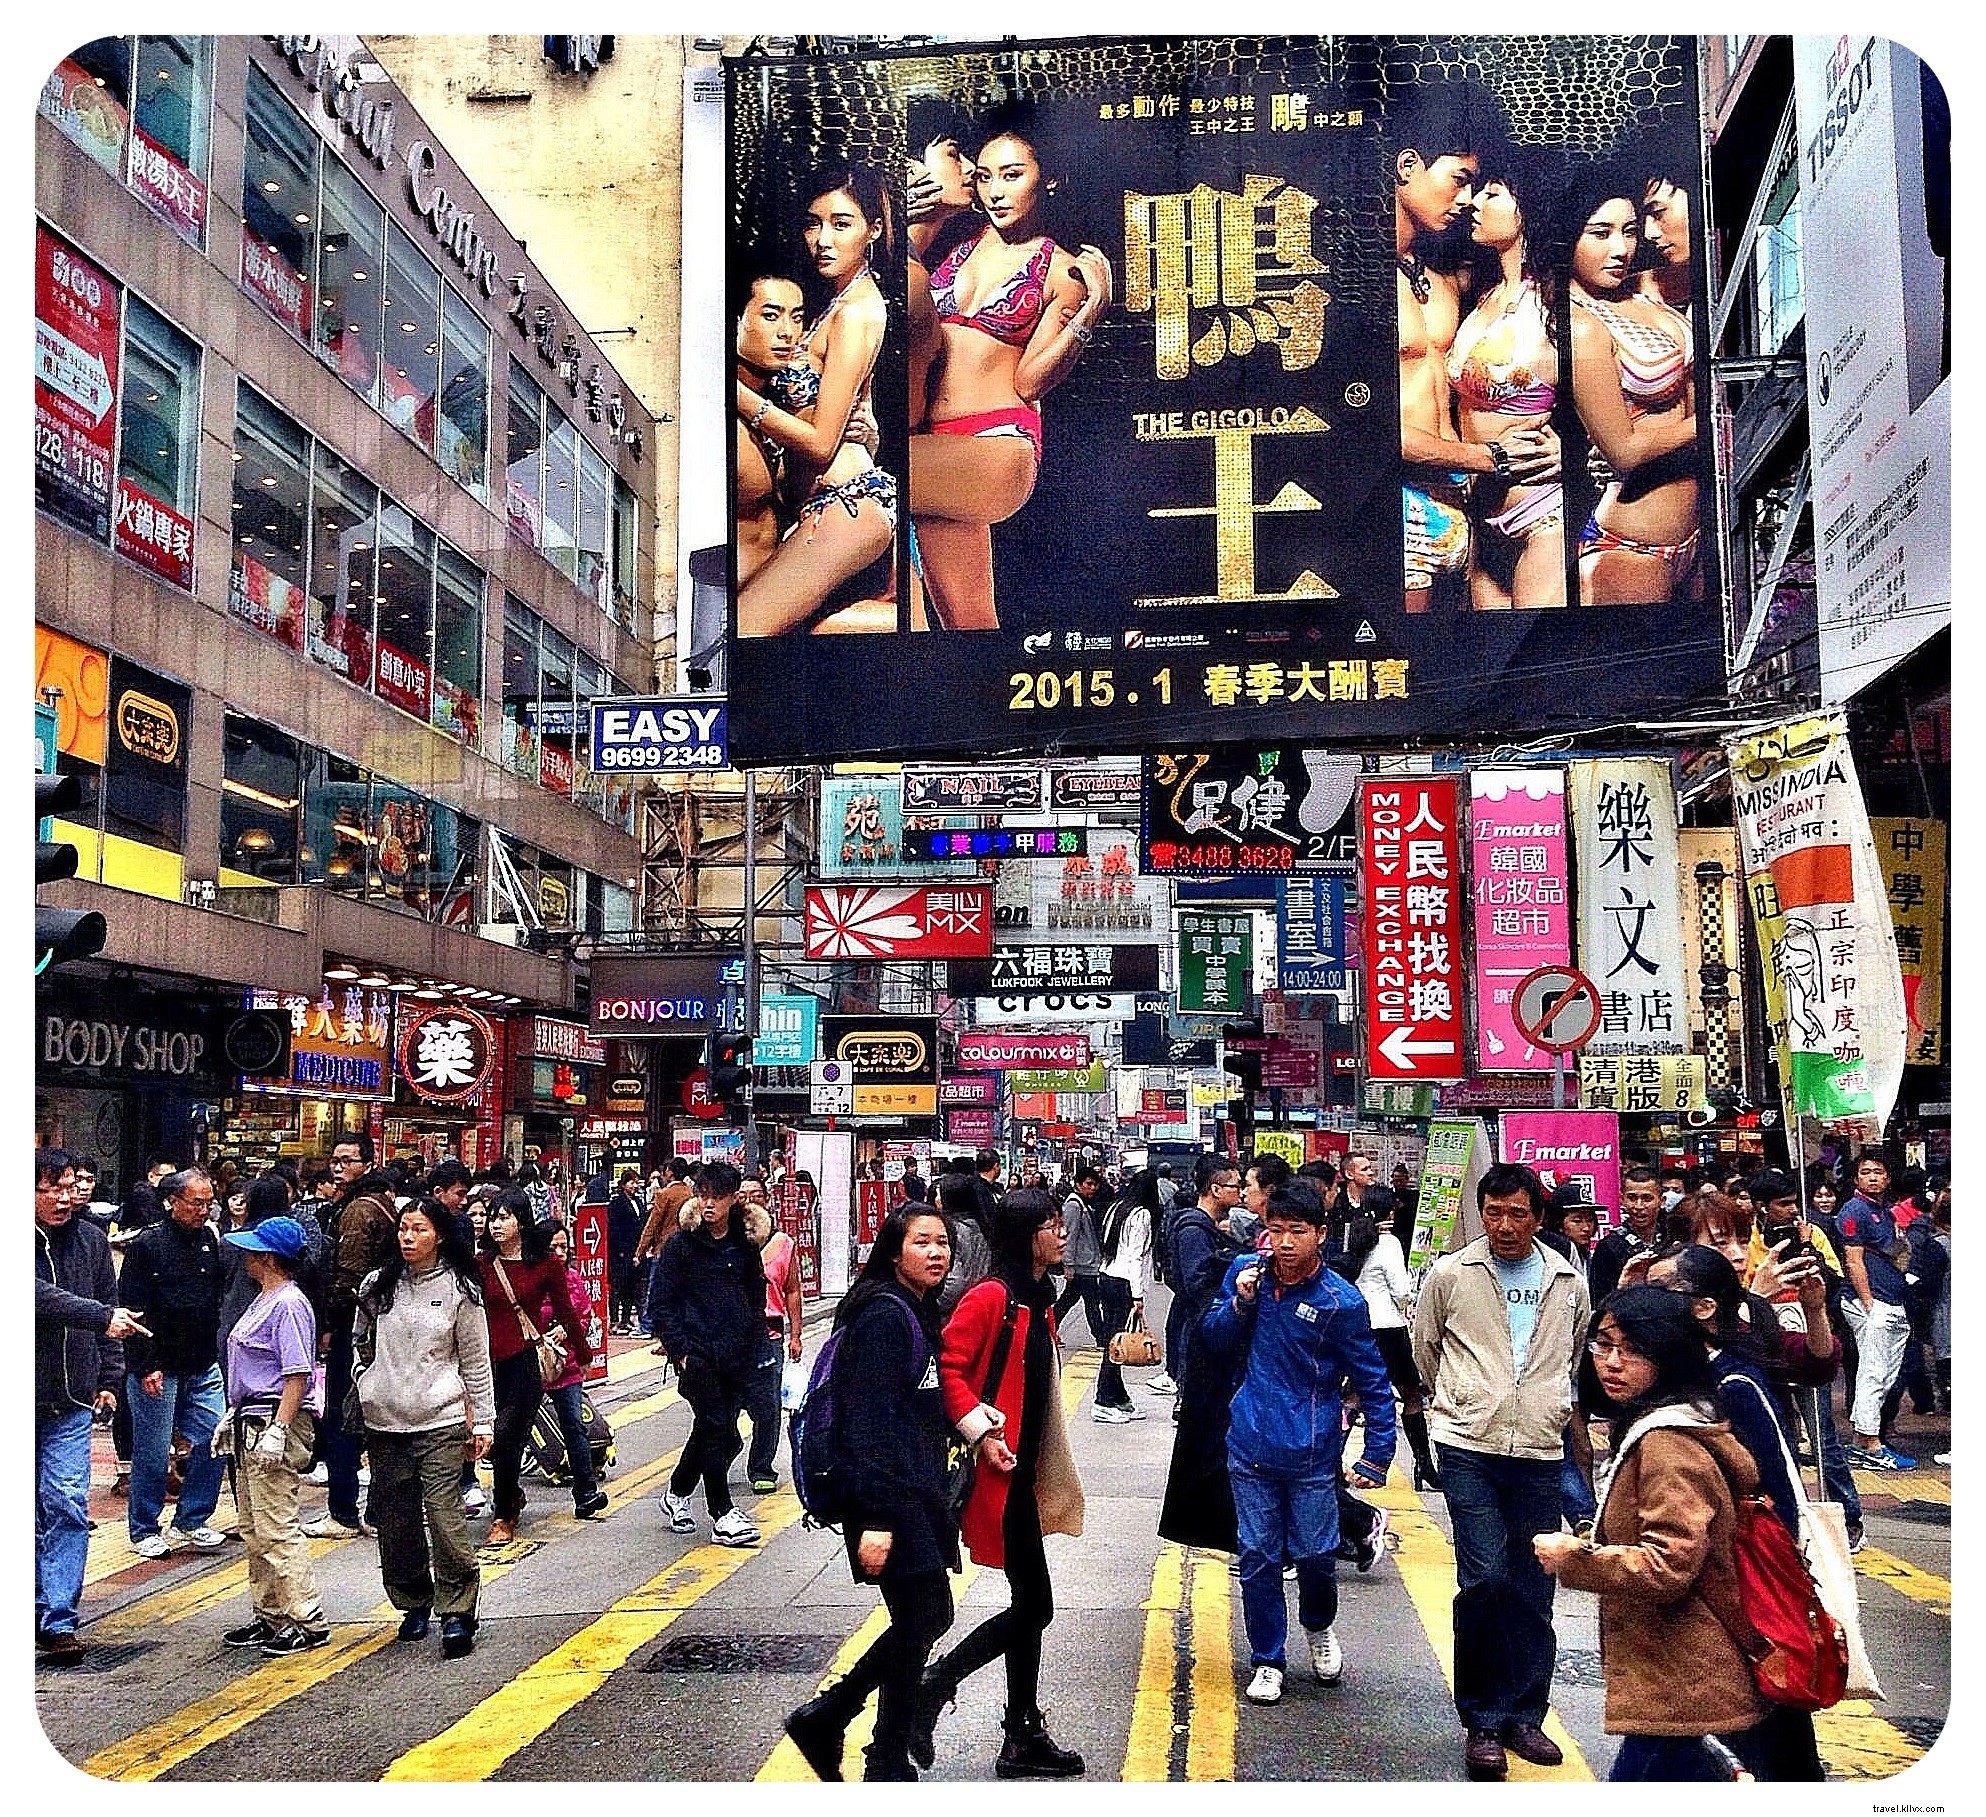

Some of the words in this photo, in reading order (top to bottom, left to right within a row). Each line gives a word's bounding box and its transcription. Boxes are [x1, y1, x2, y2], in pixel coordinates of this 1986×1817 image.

[1099, 94, 1180, 120] 最多動作
[1189, 96, 1255, 114] 最少特技
[1807, 36, 1875, 183] TISSOT
[1189, 116, 1256, 135] 王中之王
[407, 140, 498, 296] Centre
[1123, 173, 1341, 608] 鴨王
[1132, 411, 1184, 435] THE
[1191, 406, 1290, 430] GIGOLO
[115, 489, 192, 563] 火鍋專家
[380, 649, 426, 700] 創意小菜
[1203, 659, 1410, 706] 春季大酬賓
[603, 708, 721, 744] EASY
[602, 747, 660, 767] 9699
[663, 745, 723, 766] 2348
[940, 778, 1004, 795] NAIL
[1780, 760, 1847, 800] INDIA
[1184, 776, 1301, 845] 足健
[1371, 792, 1402, 875] MONEY
[1474, 819, 1562, 841] Emarket
[1308, 835, 1356, 858] 2/F
[1490, 846, 1547, 873] 韓國
[1477, 876, 1564, 905] 化妝品
[1597, 781, 1660, 979] 樂文
[926, 893, 983, 912] 美心
[996, 904, 1029, 924] on
[1404, 792, 1453, 1022] 人民幣找換
[927, 913, 981, 934] MX
[1492, 908, 1550, 936] 超市
[992, 946, 1114, 976] 六福珠寶
[1375, 886, 1405, 1022] EXCHANGE
[991, 976, 1044, 988] LUKFOOK
[1047, 975, 1113, 987] JEWELLERY
[1282, 971, 1342, 988] 14:00-24:00
[598, 999, 706, 1023] BONJOUR
[1600, 989, 1673, 1034] 書店
[44, 1016, 131, 1067] BODY
[133, 1026, 205, 1075] SHOP
[413, 1020, 477, 1088] 藥
[961, 1044, 1057, 1061] colourmix
[1583, 1059, 1619, 1110] 清貨
[1625, 1058, 1662, 1111] 港版
[1512, 1139, 1612, 1163] Emarket
